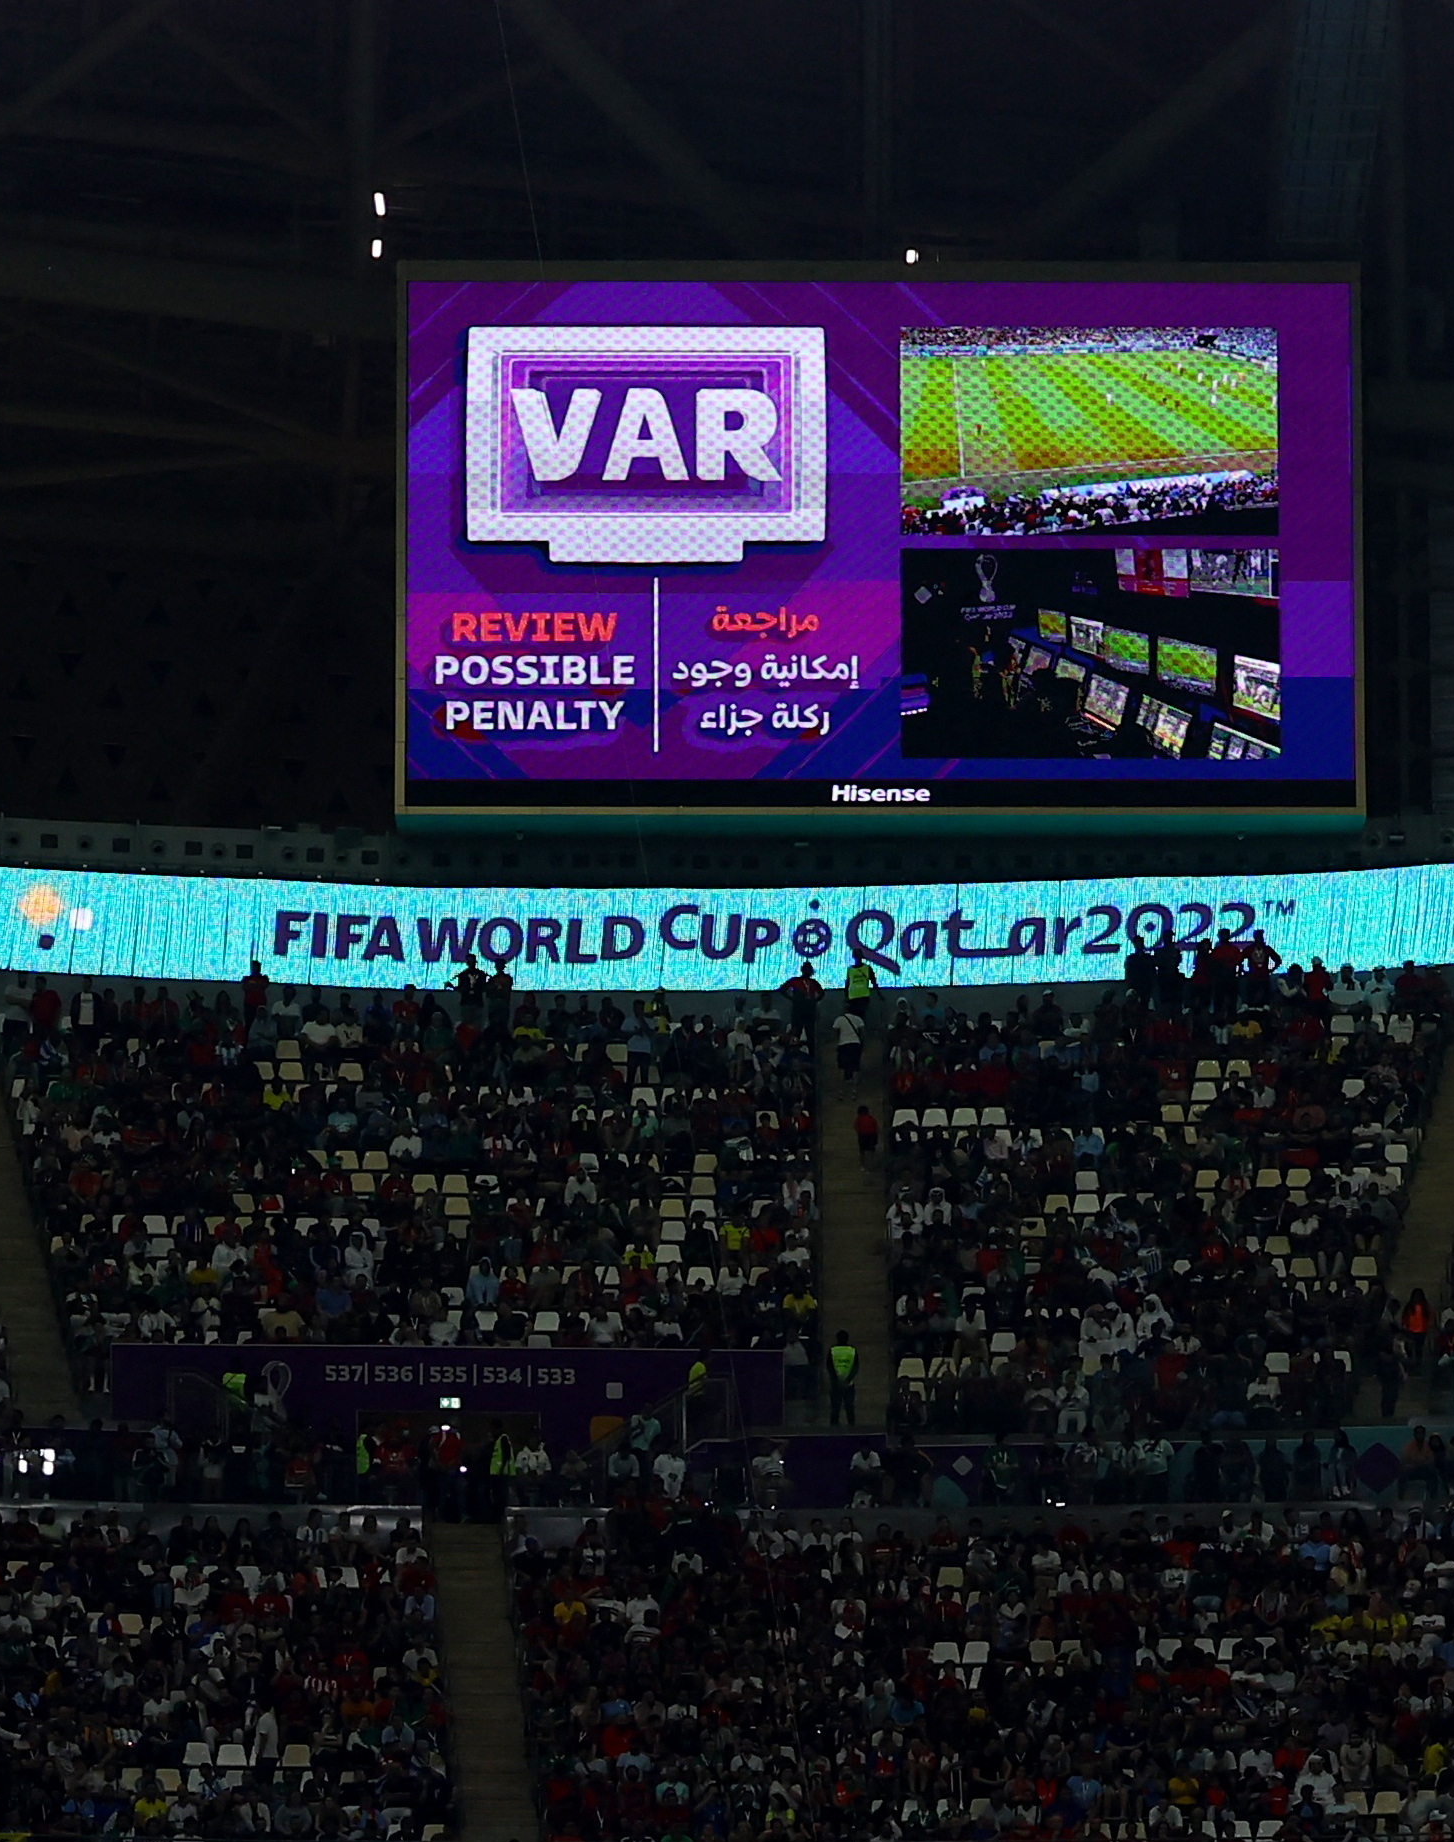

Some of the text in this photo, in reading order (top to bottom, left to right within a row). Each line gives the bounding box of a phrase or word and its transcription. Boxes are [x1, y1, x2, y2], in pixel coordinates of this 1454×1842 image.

[512, 388, 782, 483] VAR
[452, 612, 617, 642] REVIEW
[712, 606, 819, 638] مراجعة
[435, 655, 635, 686] POSSIBLE
[672, 654, 859, 690] إمكانية وجود
[446, 700, 625, 730] PENALTY
[700, 703, 830, 737] ركلة جزاء
[831, 784, 931, 802] Hisense
[273, 910, 405, 962] FIFA
[417, 915, 645, 964] WORLD
[659, 904, 781, 965] CUP
